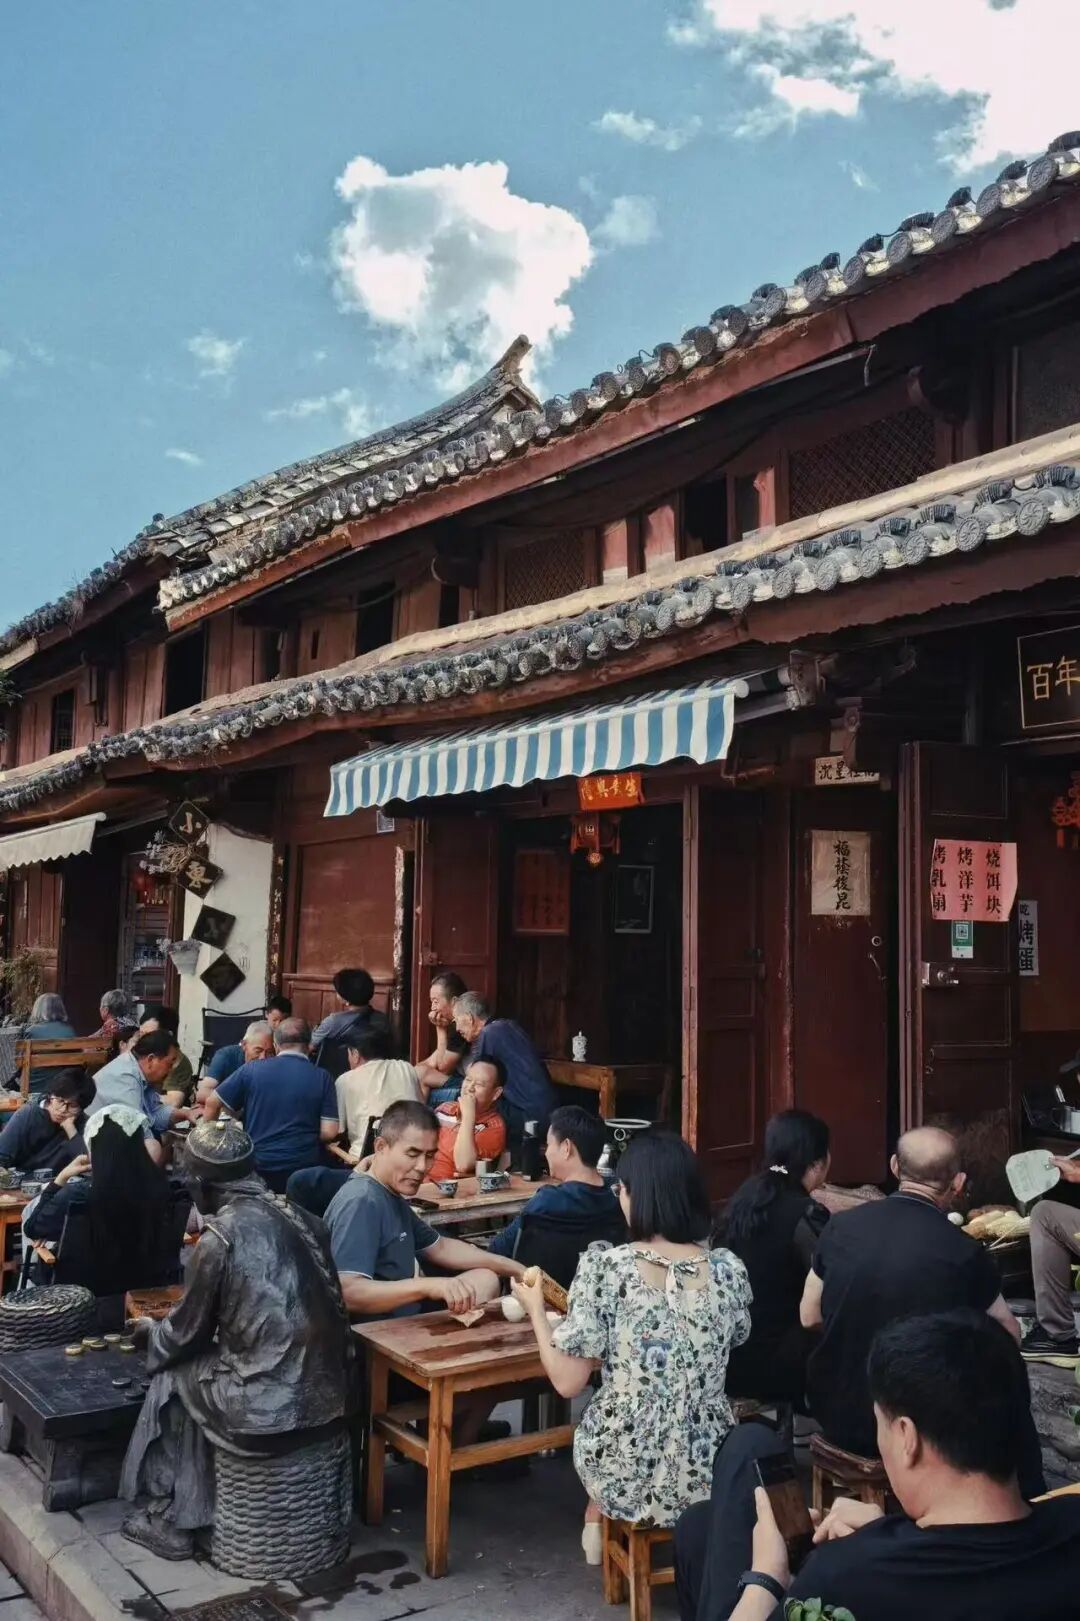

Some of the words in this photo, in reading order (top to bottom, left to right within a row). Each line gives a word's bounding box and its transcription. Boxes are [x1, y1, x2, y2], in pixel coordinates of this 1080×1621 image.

[1027, 655, 1080, 701] 百年
[931, 845, 947, 912] 烤乳扇
[957, 846, 975, 913] 烤洋芋
[985, 848, 1003, 914] 烧饵块
[1019, 904, 1034, 971] 吃烤蛋
